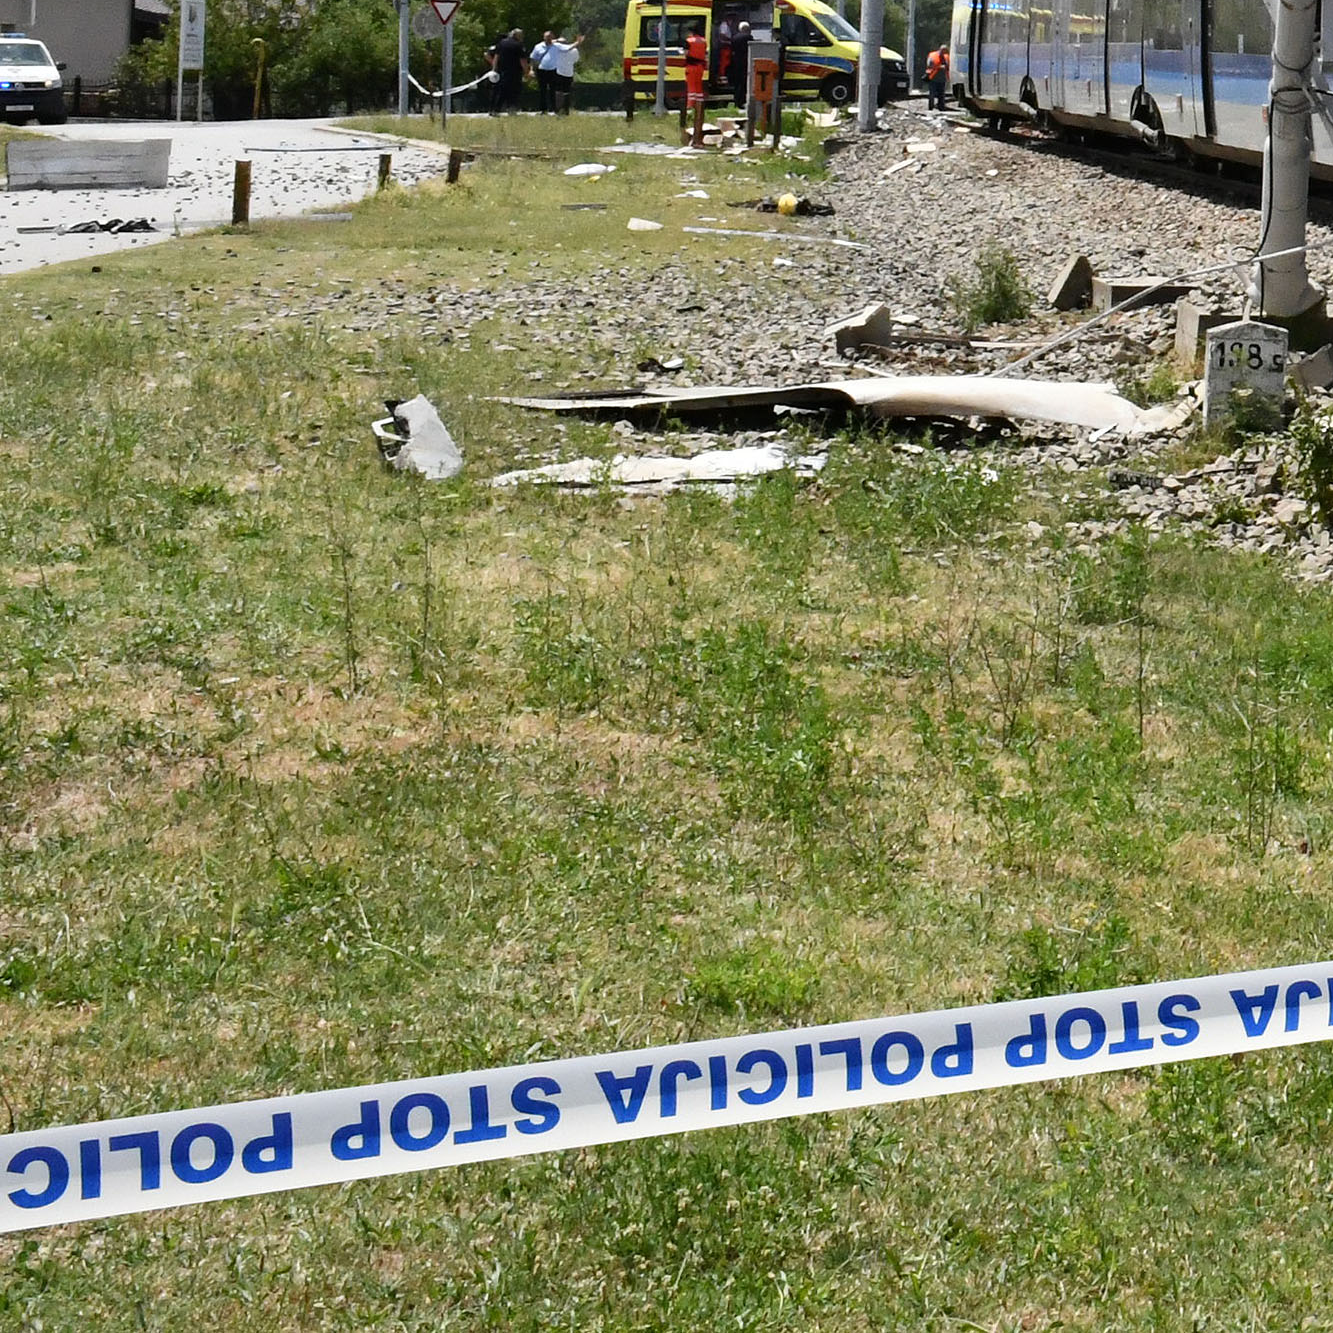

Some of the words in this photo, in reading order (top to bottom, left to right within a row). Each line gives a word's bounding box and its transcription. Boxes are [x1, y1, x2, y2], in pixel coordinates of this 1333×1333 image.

[756, 71, 772, 92] T
[1005, 994, 1201, 1068] STOP
[595, 1023, 974, 1124] POLICIJA
[7, 1112, 294, 1209] POLIC
[330, 1077, 561, 1161] STOP
